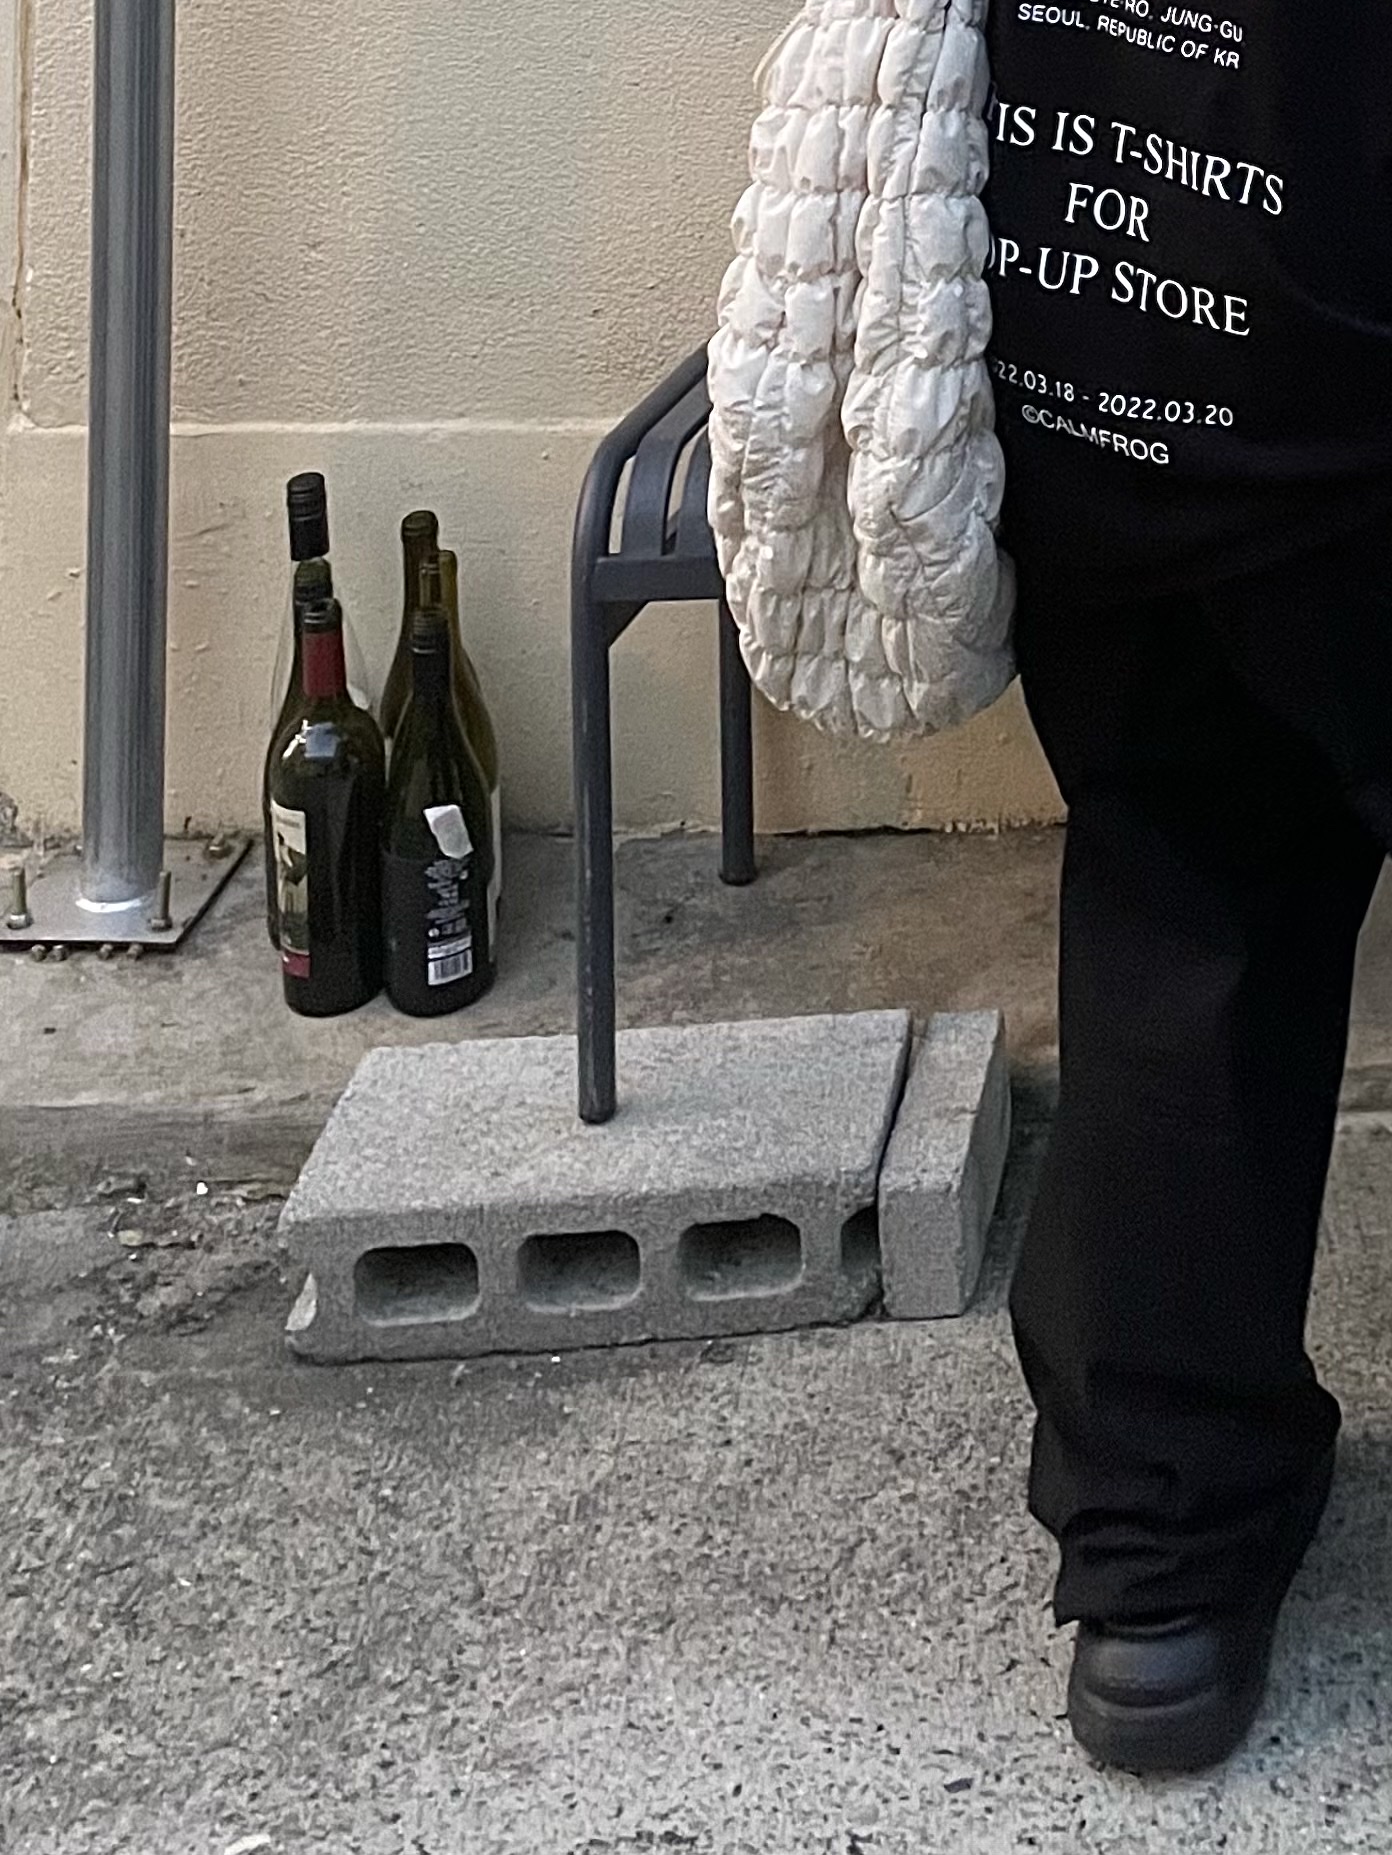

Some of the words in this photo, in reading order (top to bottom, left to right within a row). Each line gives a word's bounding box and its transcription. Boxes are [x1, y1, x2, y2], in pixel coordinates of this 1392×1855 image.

[1096, 14, 1176, 54] REPUBLIC
[1181, 40, 1209, 60] OF
[1213, 47, 1240, 70] KR
[1160, 6, 1243, 43] JUNG-GU
[994, 101, 1037, 147] IS
[1051, 111, 1096, 157] IS
[1110, 121, 1284, 216] T-SHIRTS
[1063, 182, 1150, 243] FOR
[989, 234, 1100, 295] P-UP
[1111, 260, 1251, 337] STORE
[1098, 391, 1234, 427] 2022.03.20
